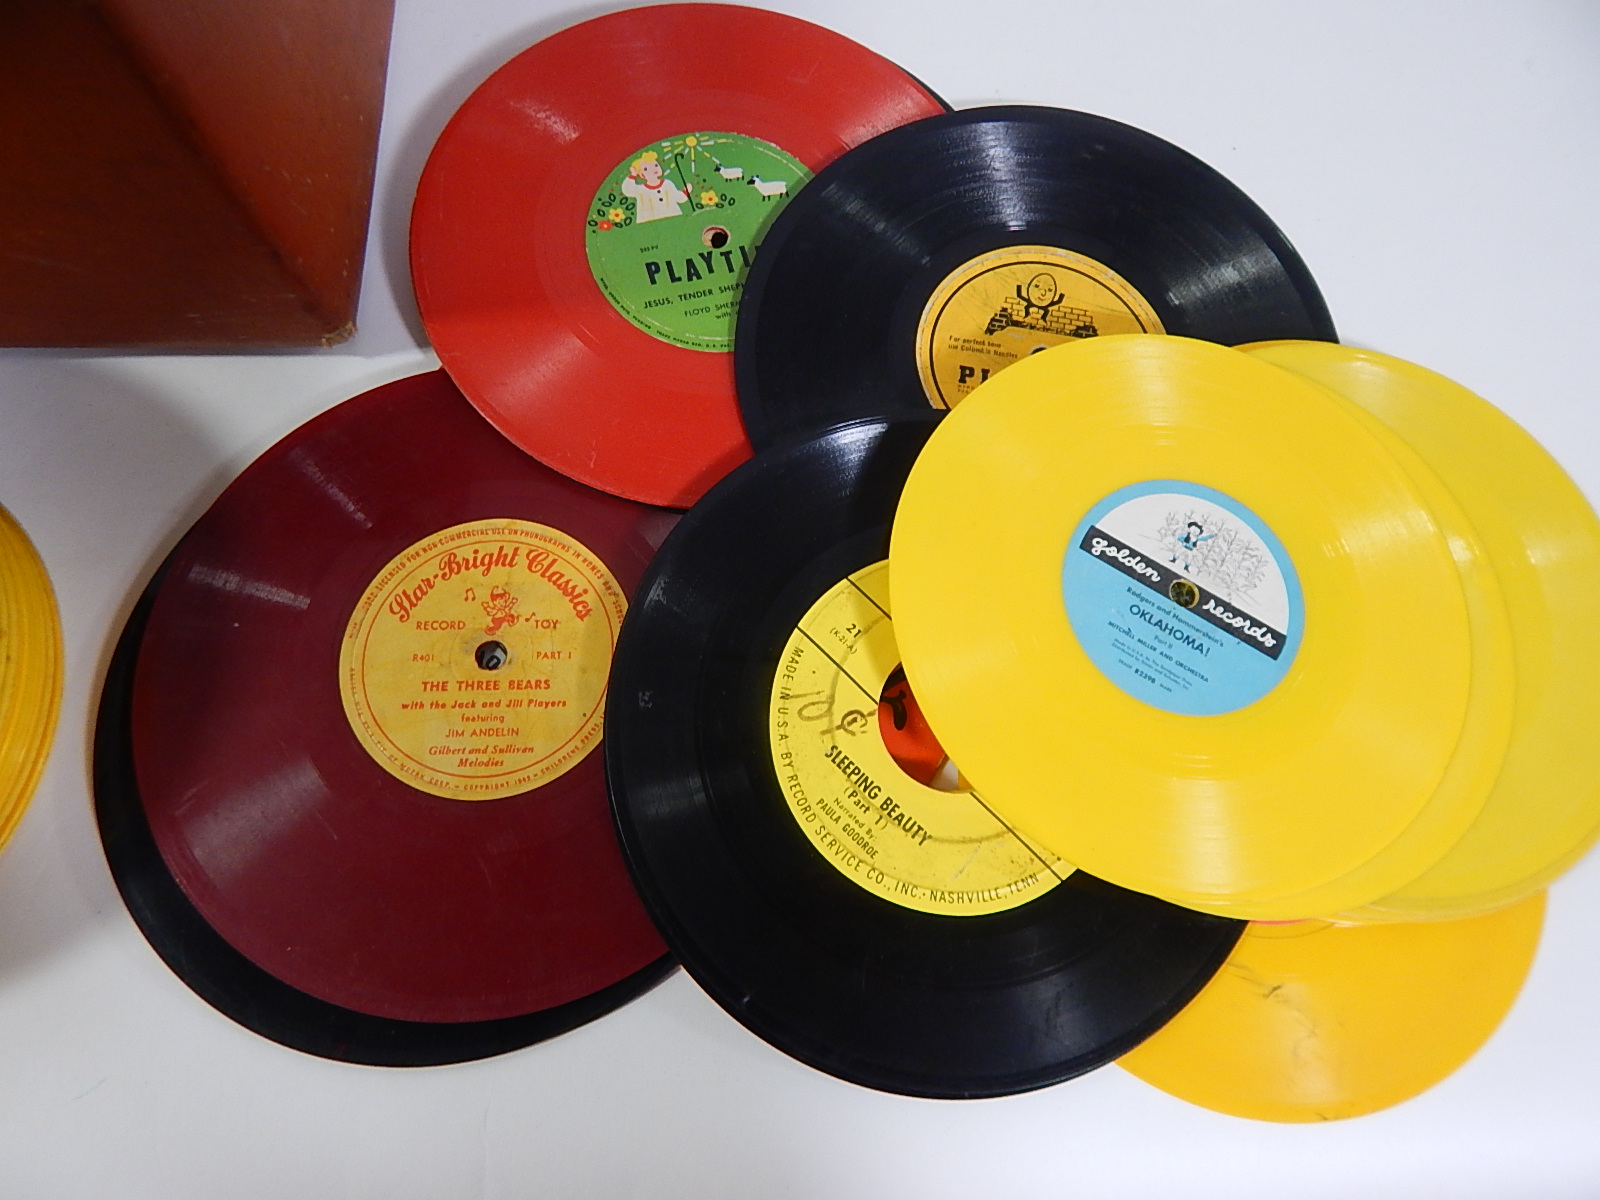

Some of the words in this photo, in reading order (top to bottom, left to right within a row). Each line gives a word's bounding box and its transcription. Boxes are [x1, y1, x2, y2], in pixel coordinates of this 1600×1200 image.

[645, 245, 761, 285] PLAYTI
[643, 297, 674, 309] JESUS,
[678, 289, 714, 302] TENDER
[684, 306, 711, 318] FLOYD
[963, 338, 986, 346] perfect
[525, 548, 593, 622] Classics
[1091, 536, 1161, 583] golden
[1202, 598, 1277, 648] records
[1156, 605, 1172, 616] and
[415, 620, 467, 631] RECORD
[535, 619, 559, 630] TOY
[846, 623, 863, 639] 21
[1129, 604, 1211, 657] OKLAHOMA!
[536, 651, 562, 660] PART
[782, 646, 804, 682] MADE
[1159, 650, 1174, 662] AND
[1175, 660, 1209, 683] ORCHESTRA
[421, 681, 449, 692] THE
[456, 680, 500, 692] THREE
[508, 679, 551, 691] BEARS
[779, 686, 792, 700] IN
[401, 700, 425, 710] with
[429, 700, 447, 710] the
[451, 700, 477, 709] Jack
[481, 699, 502, 709] and
[505, 698, 523, 709] Jill
[527, 698, 567, 709] Players
[461, 713, 505, 724] featuring
[776, 706, 789, 747] U.S.A.
[445, 729, 465, 738] JIM
[469, 727, 519, 738] ANDELIN
[428, 745, 466, 756] Gilbert
[468, 745, 488, 755] and
[491, 744, 534, 755] Sullivan
[457, 757, 504, 768] Melodies
[780, 751, 795, 769] BY
[787, 773, 817, 823] RECORD
[824, 745, 882, 800] SLEEPING
[879, 796, 933, 847] BEAUTY
[843, 787, 871, 814] (Part
[833, 797, 865, 829] Narrated
[815, 798, 842, 825] PAULA
[842, 823, 879, 860] GOODROE
[815, 825, 863, 873] SERVICE
